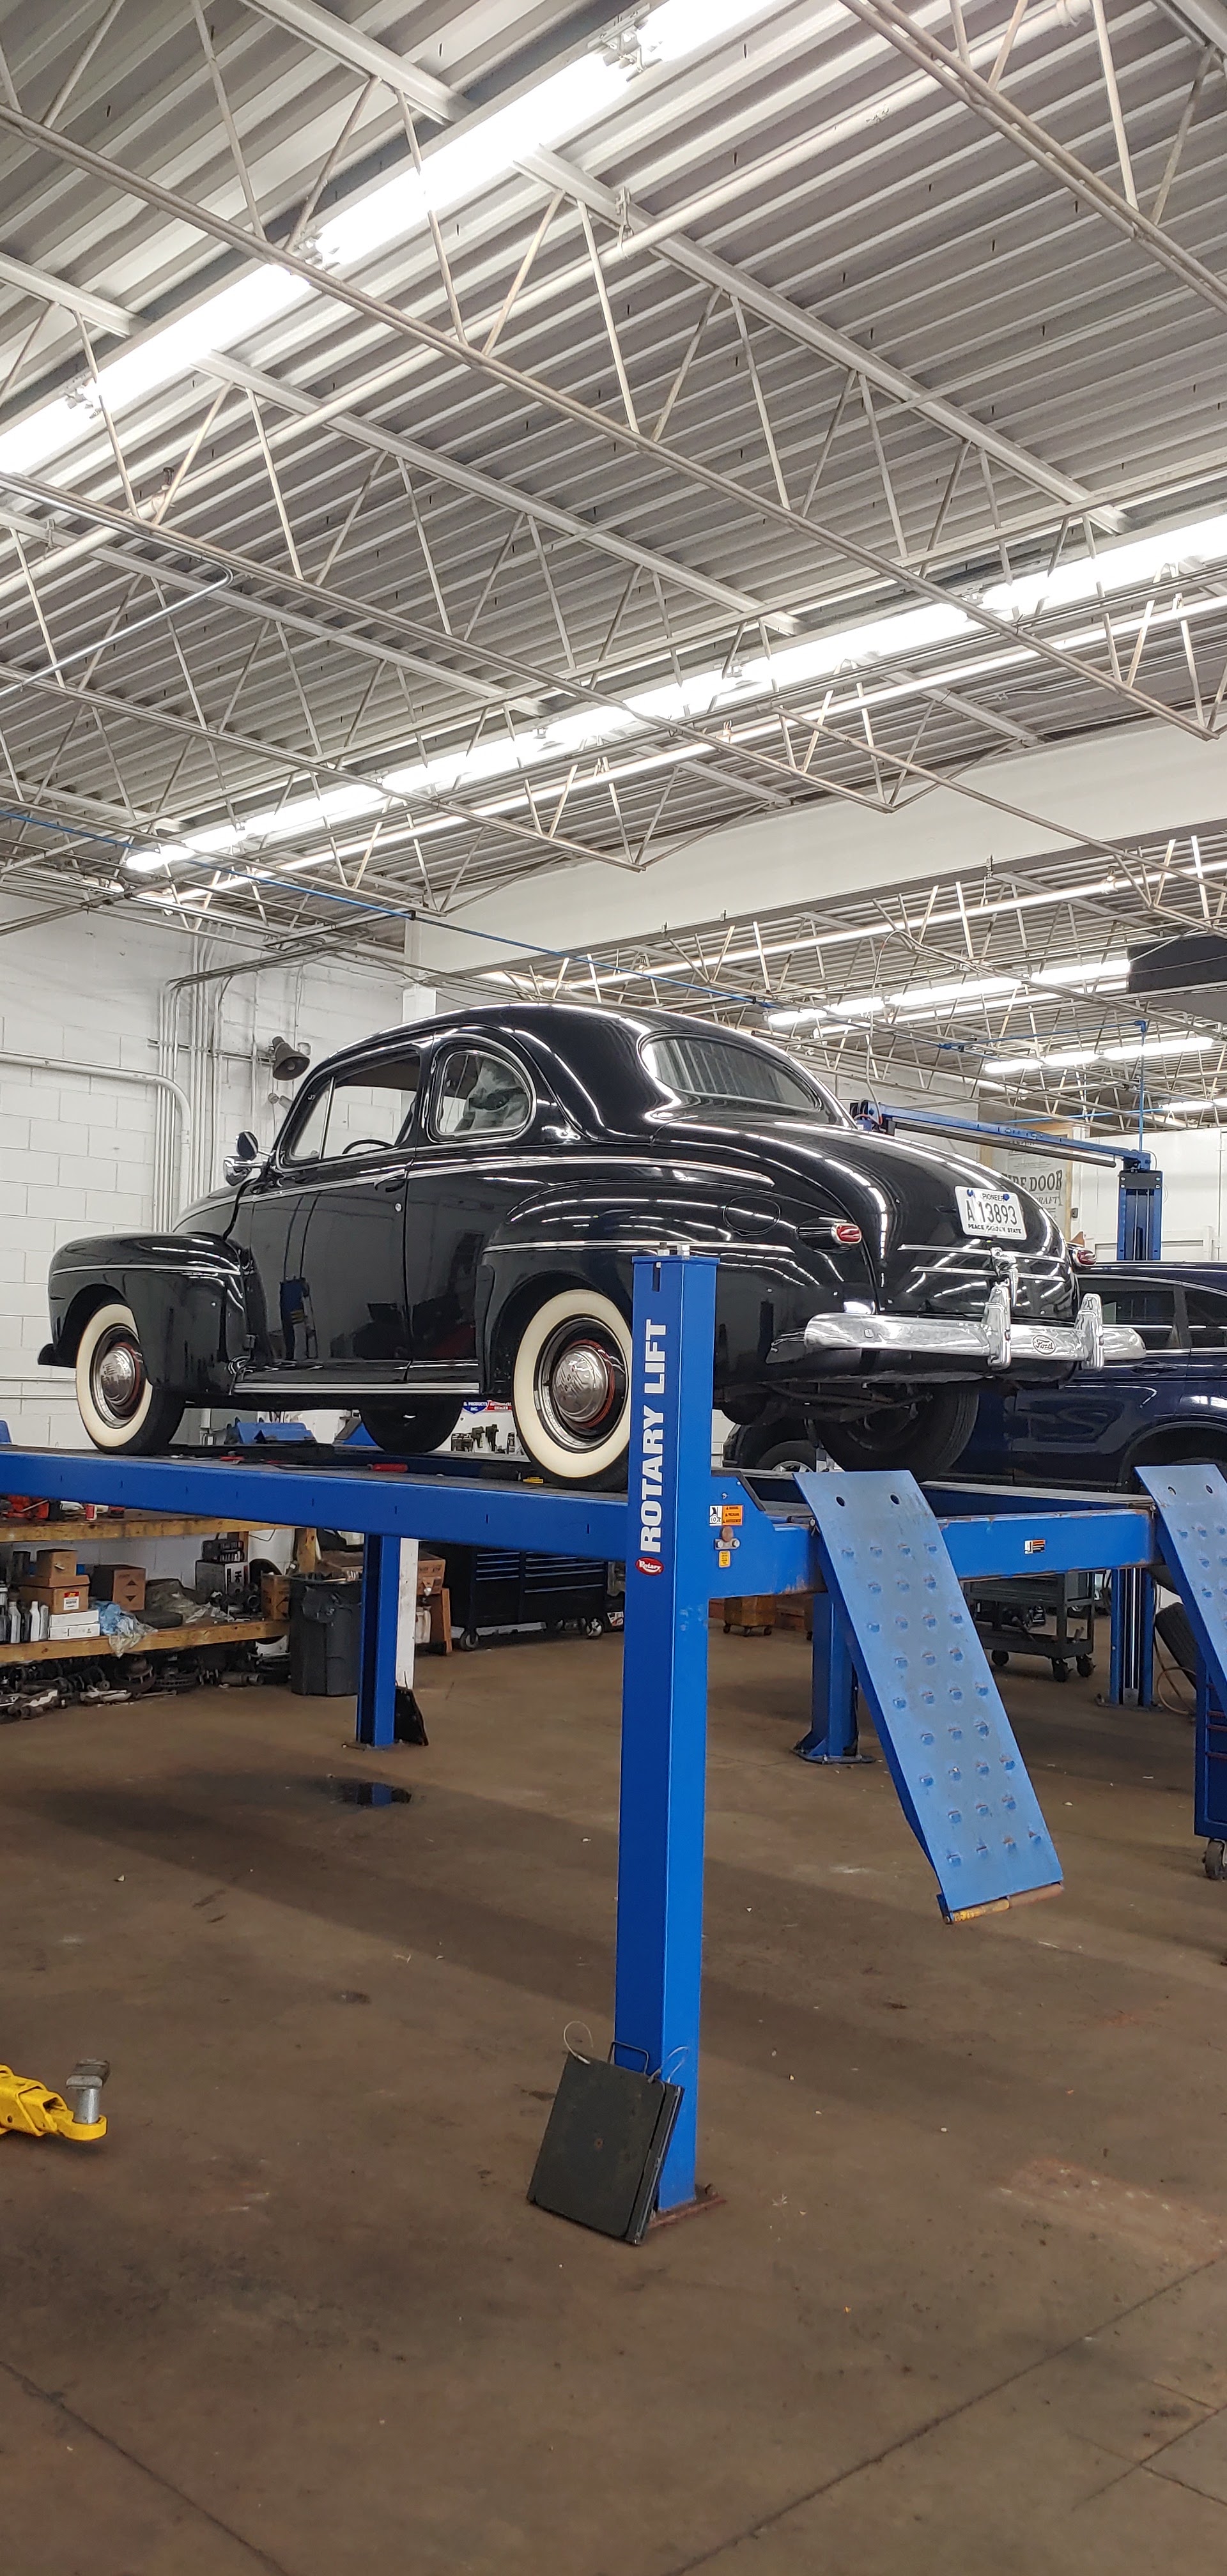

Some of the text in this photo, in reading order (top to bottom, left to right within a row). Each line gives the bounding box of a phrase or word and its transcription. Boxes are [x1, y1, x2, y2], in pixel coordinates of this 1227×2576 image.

[1030, 1170, 1063, 1192] DOOR
[1036, 1196, 1060, 1205] RAFT
[978, 1201, 1017, 1225] 13893
[640, 1319, 667, 1552] ROTARY LIFT
[638, 1560, 661, 1572] Rotary
